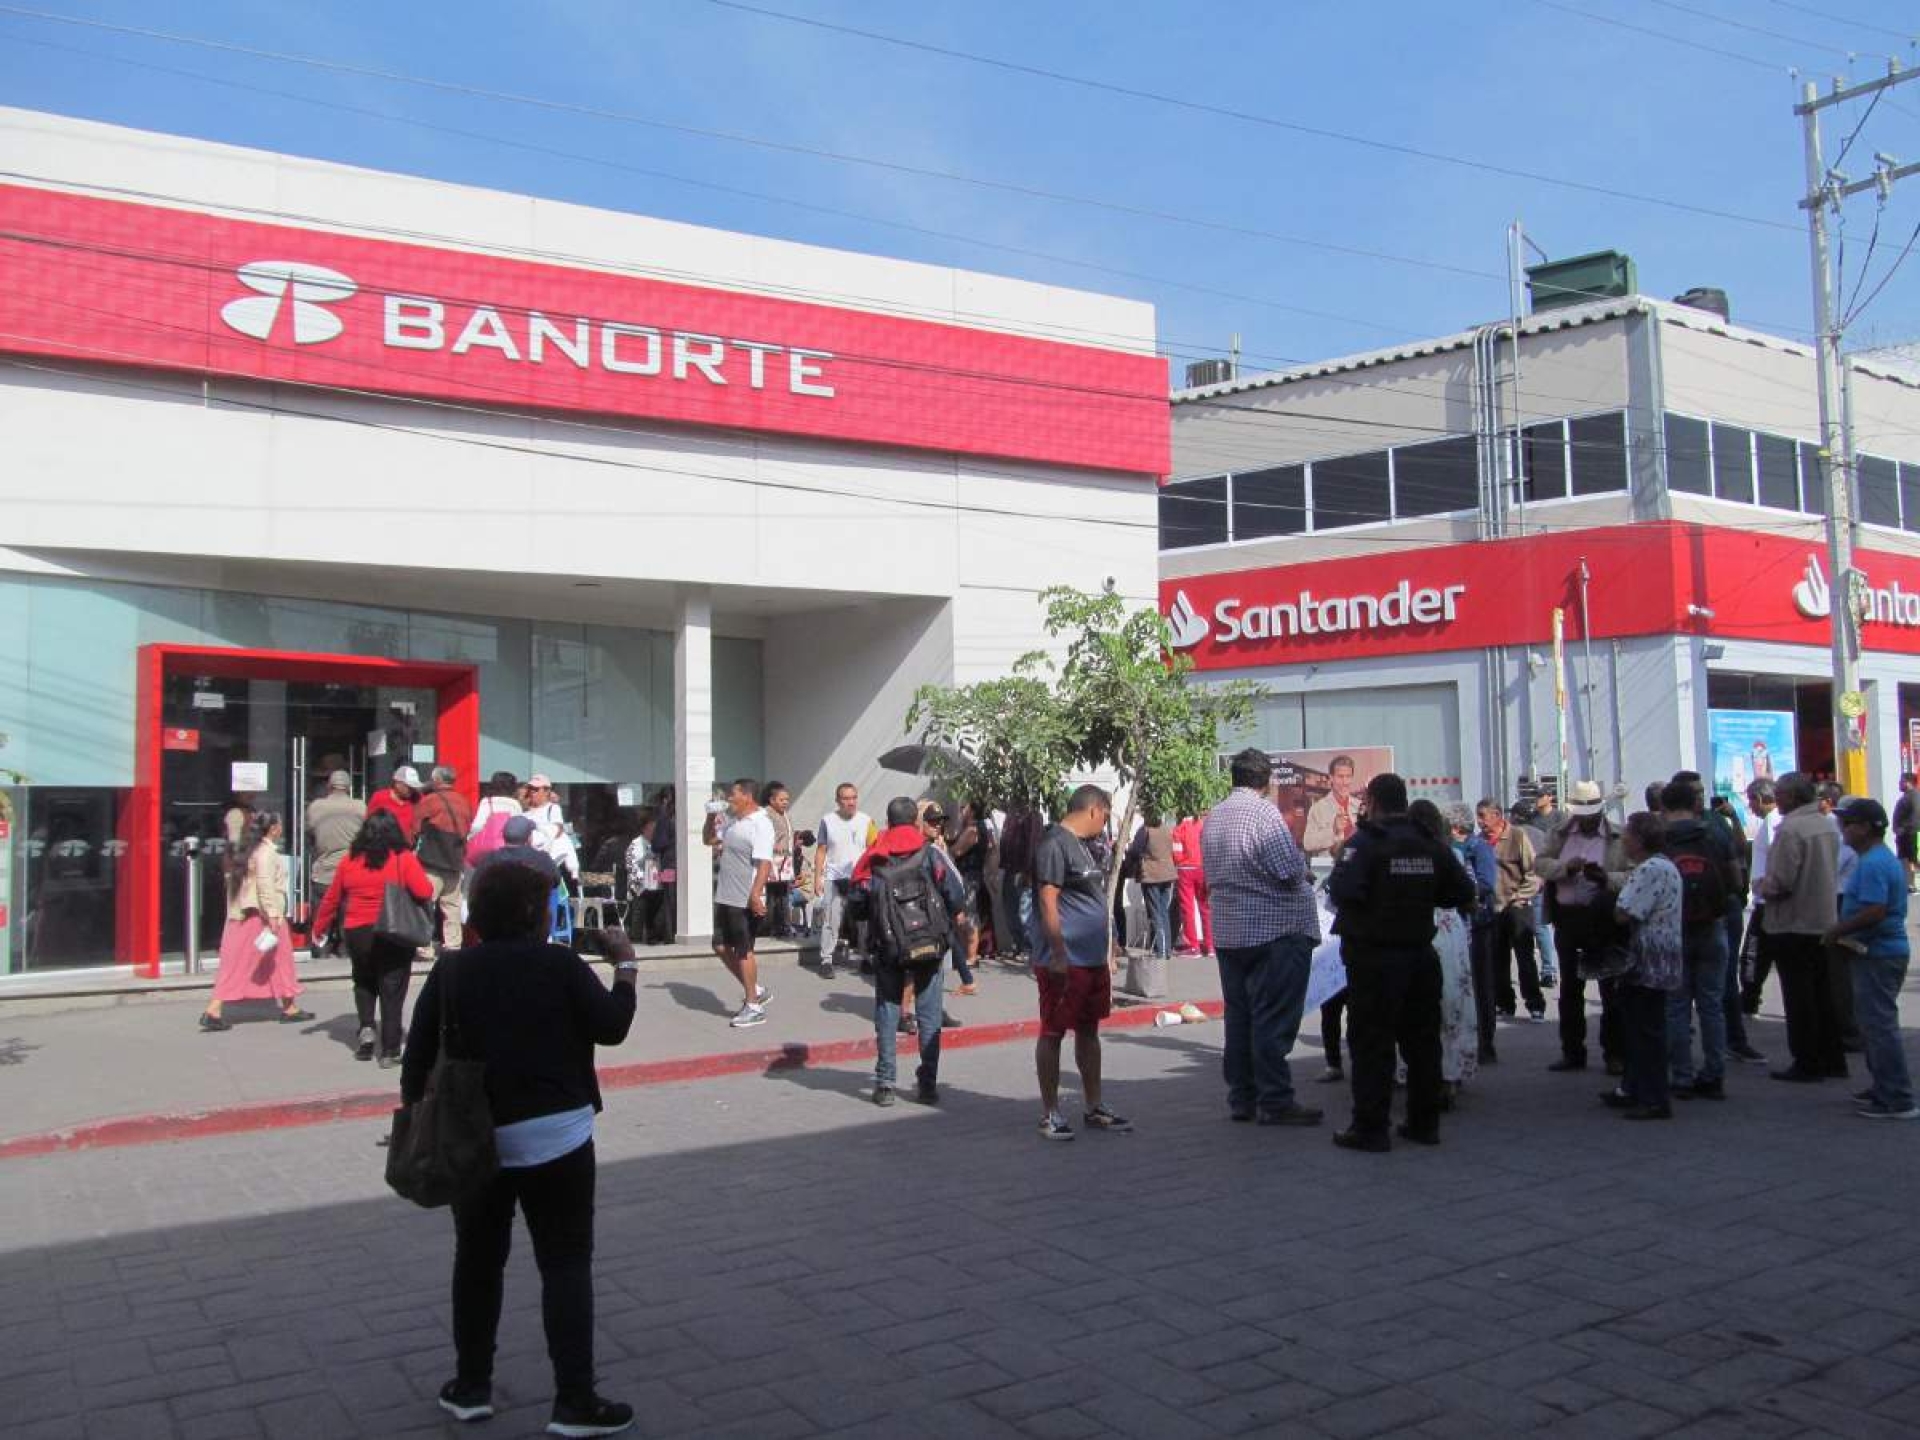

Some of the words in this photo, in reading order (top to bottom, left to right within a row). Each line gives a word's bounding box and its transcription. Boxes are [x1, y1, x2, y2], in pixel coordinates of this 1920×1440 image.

[383, 294, 836, 398] BANORTE
[1215, 579, 1466, 642] Santander
[1863, 579, 1920, 625] anta
